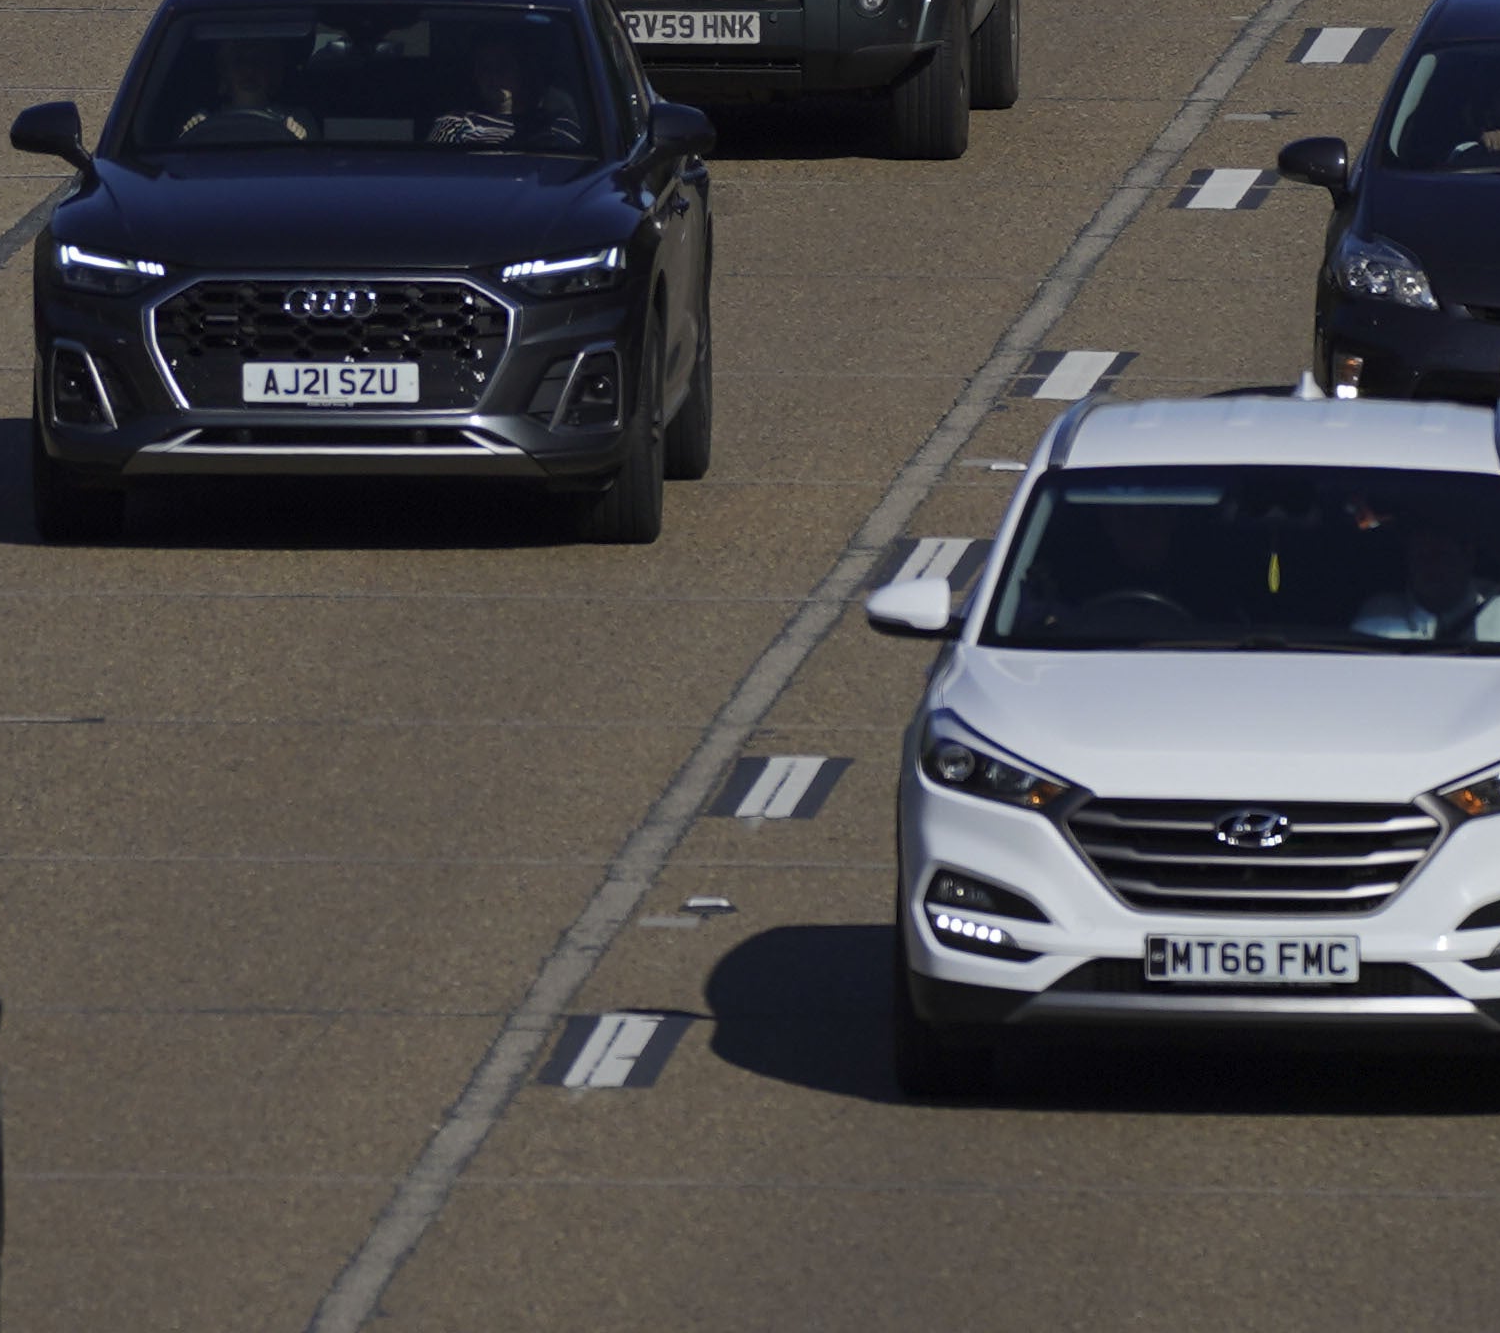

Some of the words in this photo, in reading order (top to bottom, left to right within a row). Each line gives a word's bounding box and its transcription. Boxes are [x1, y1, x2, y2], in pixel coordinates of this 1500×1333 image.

[624, 13, 695, 38] RV59
[702, 14, 755, 39] HNK
[263, 367, 330, 395] AJ21
[339, 367, 398, 395] SZU
[1171, 942, 1265, 975] MT66
[1278, 941, 1349, 975] FMC
